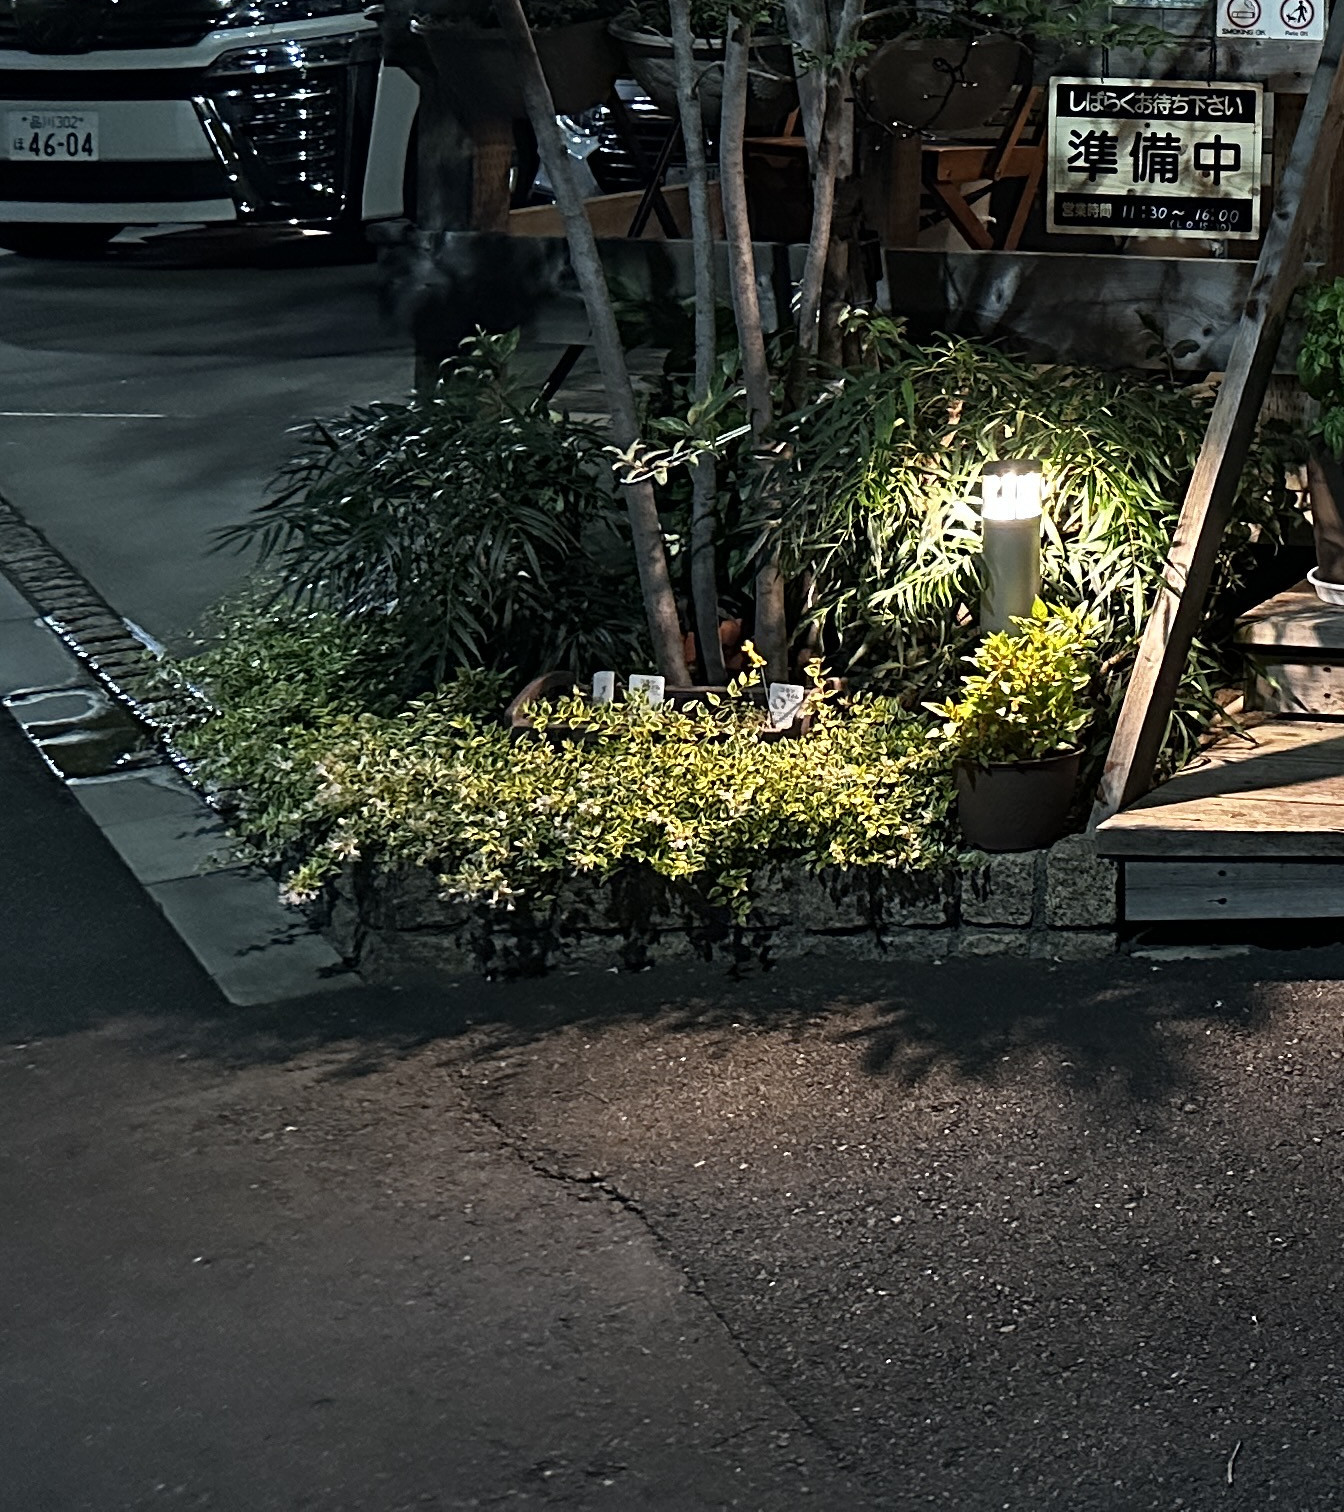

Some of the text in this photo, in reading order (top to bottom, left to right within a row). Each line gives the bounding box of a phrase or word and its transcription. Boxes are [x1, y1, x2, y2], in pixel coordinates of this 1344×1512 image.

[1069, 90, 1243, 116] しばらくお待ち下さい
[29, 132, 93, 157] 46-04
[1067, 129, 1241, 186] 準備中
[1062, 203, 1112, 219] 営業時間
